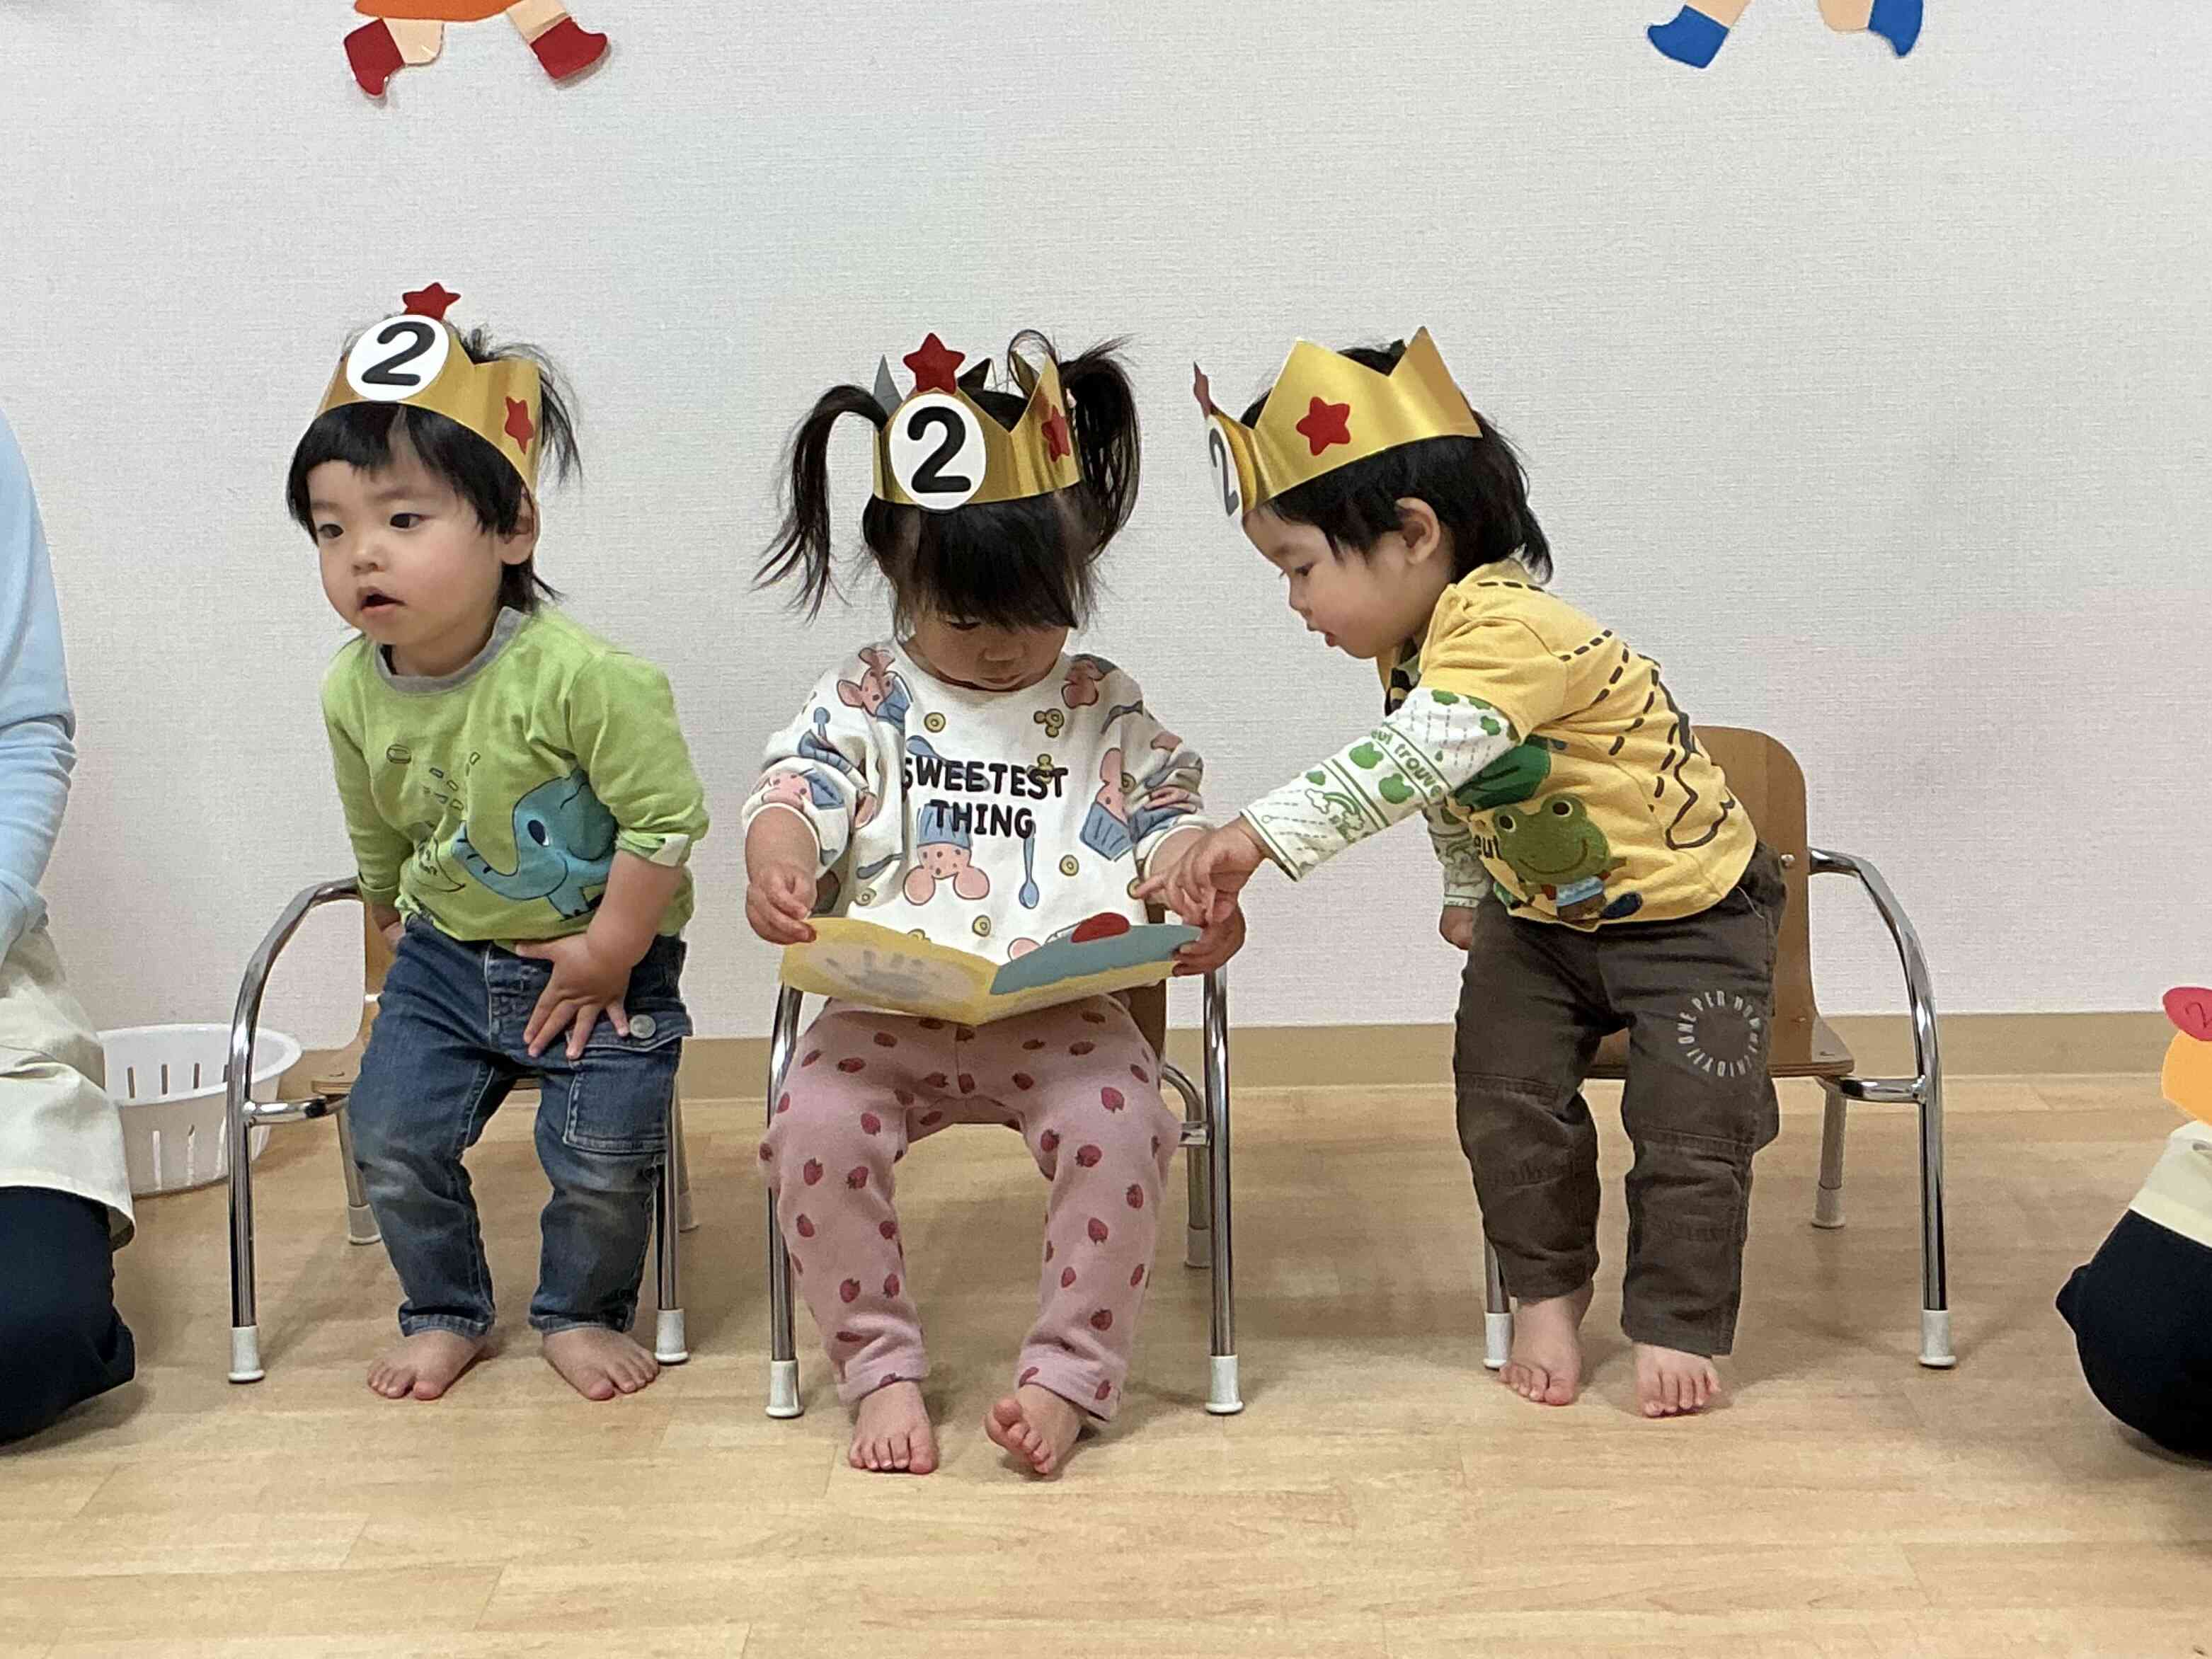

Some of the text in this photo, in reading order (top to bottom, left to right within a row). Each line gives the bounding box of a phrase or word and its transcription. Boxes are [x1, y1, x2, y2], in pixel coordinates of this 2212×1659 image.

[361, 321, 436, 387] 2
[907, 406, 972, 494] 2
[1208, 427, 1240, 517] 2
[929, 798, 1033, 839] THING
